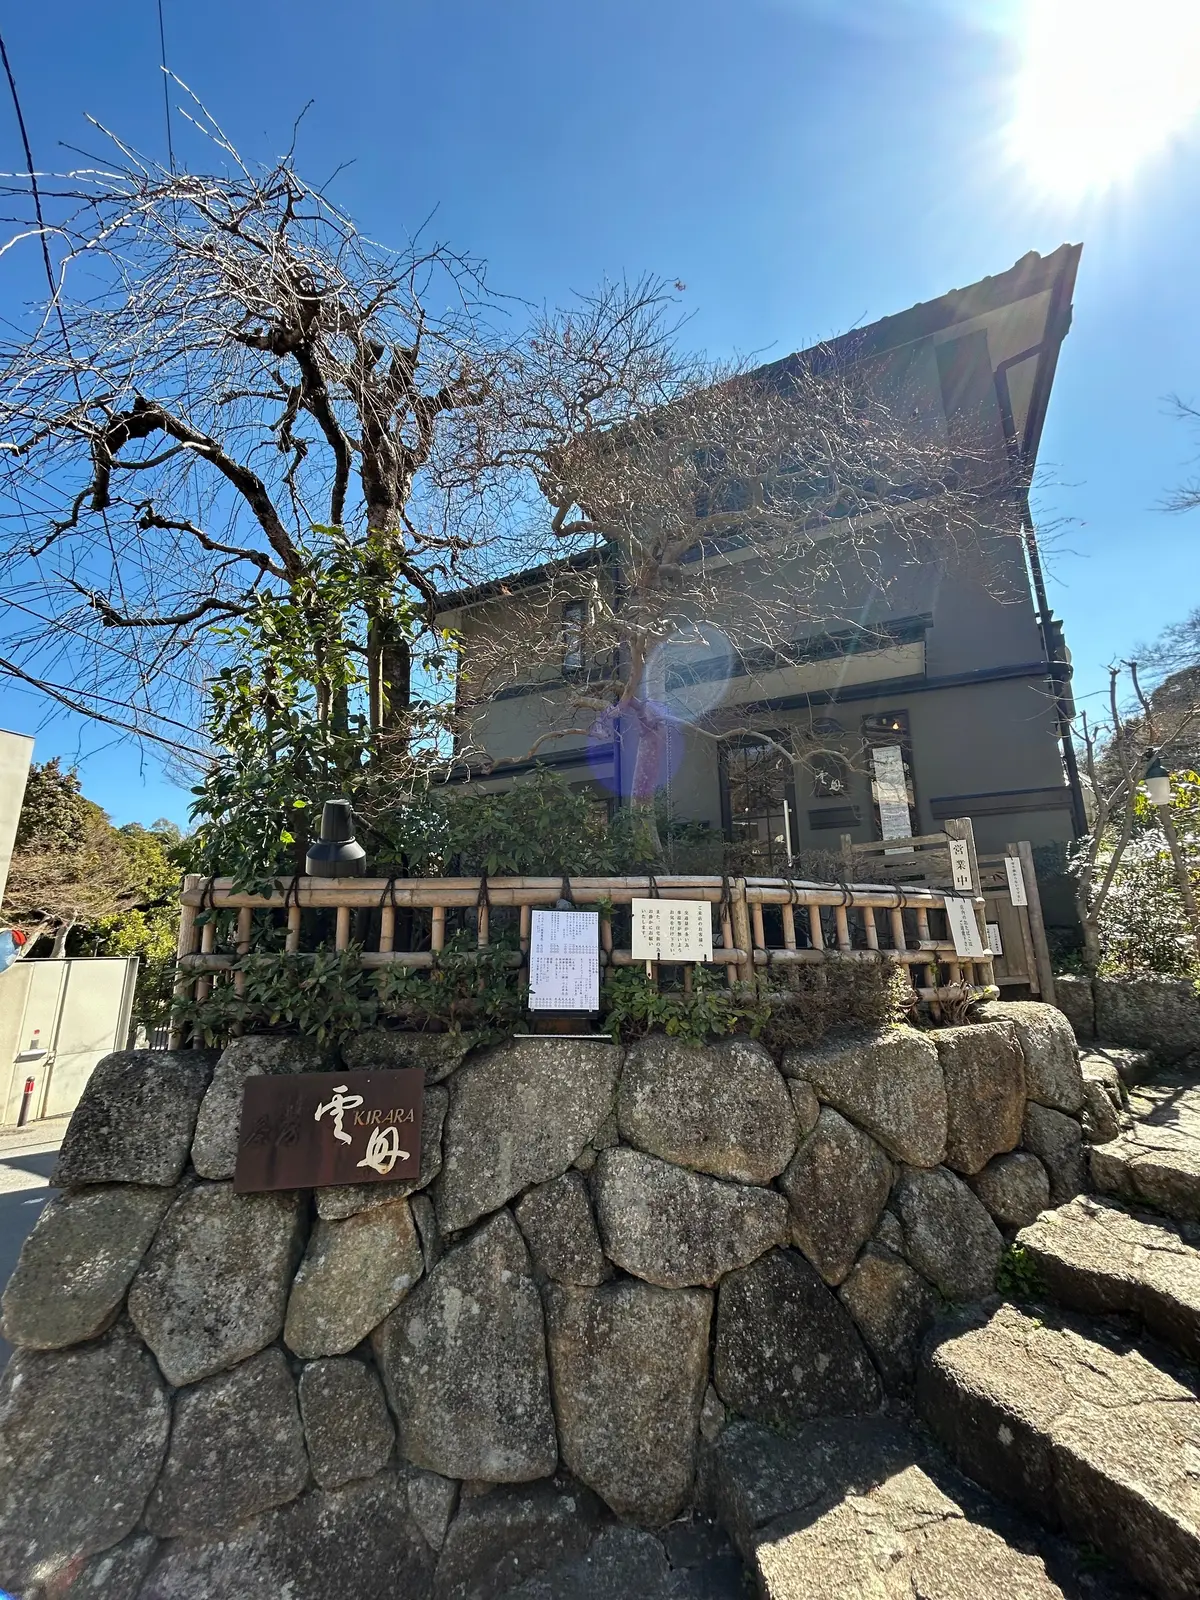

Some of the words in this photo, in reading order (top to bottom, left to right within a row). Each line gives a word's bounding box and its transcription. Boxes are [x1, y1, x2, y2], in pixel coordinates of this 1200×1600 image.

[953, 844, 968, 886] 営業中
[314, 1084, 411, 1175] 雲母
[353, 1108, 415, 1126] KIRARA
